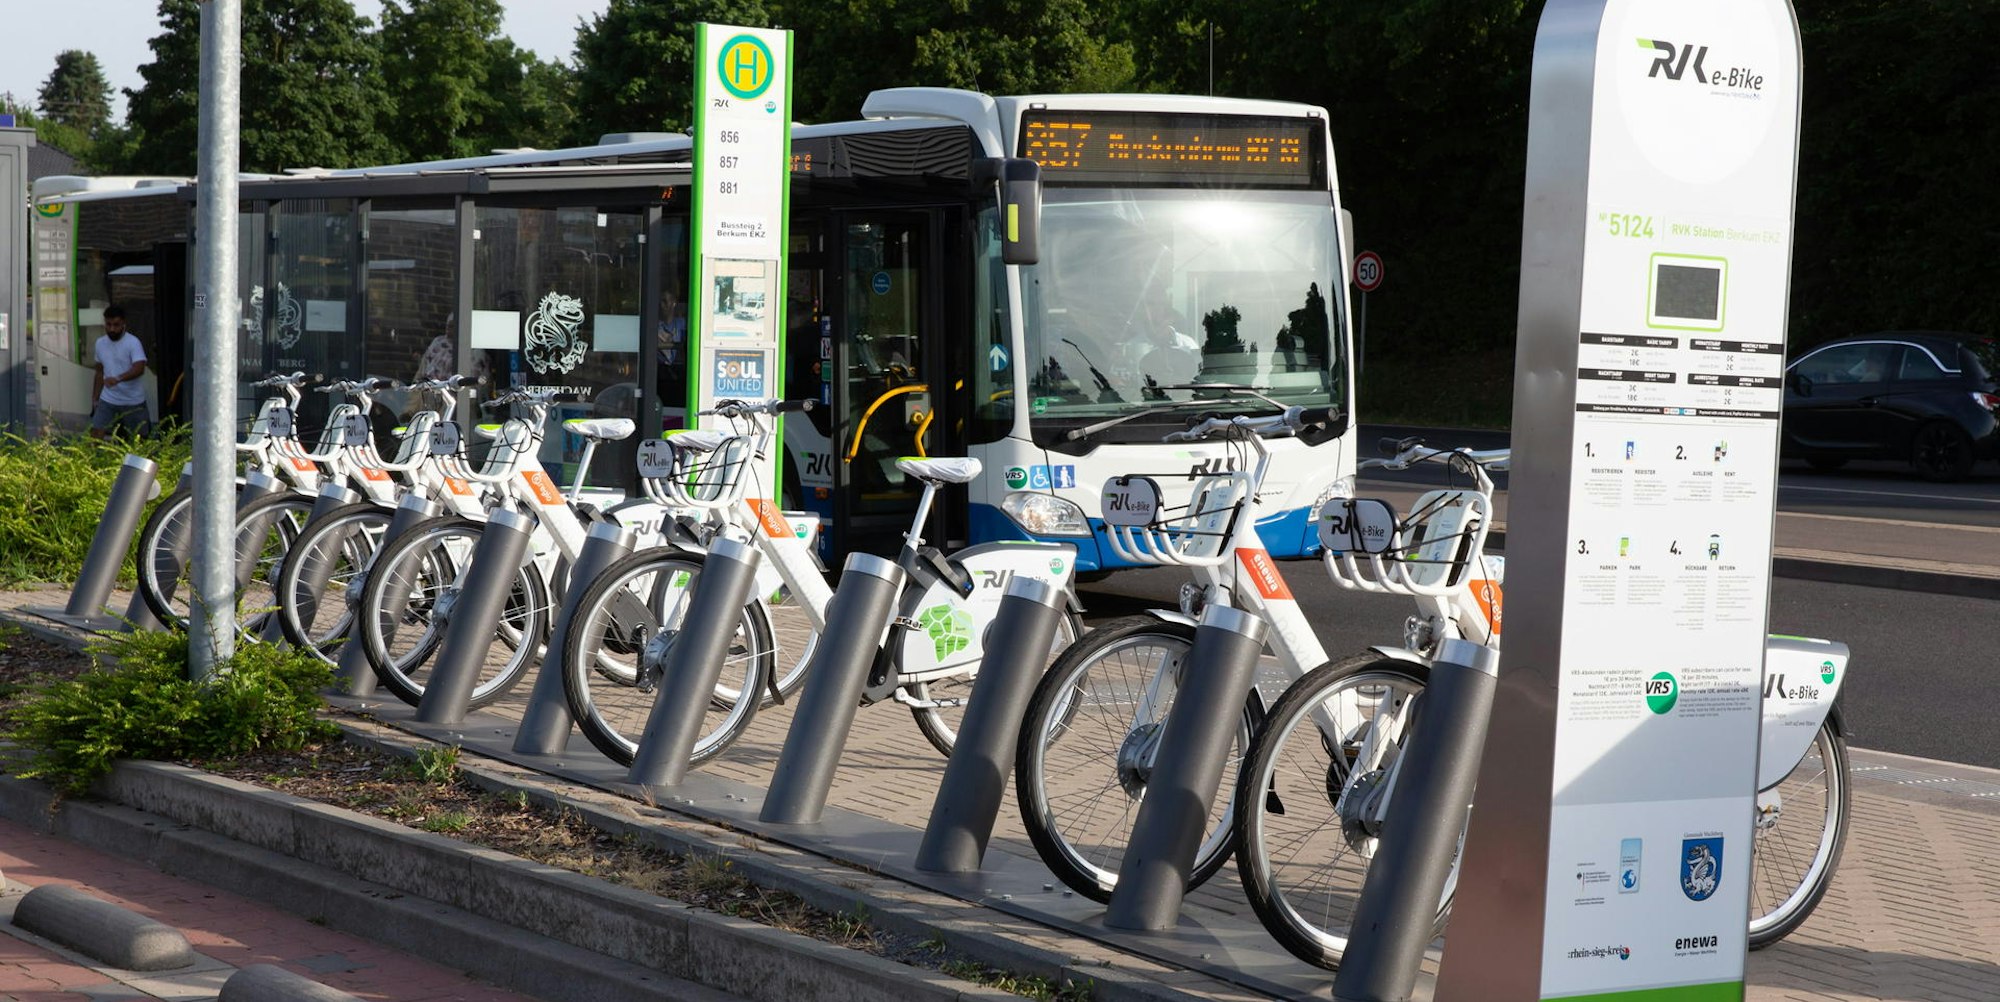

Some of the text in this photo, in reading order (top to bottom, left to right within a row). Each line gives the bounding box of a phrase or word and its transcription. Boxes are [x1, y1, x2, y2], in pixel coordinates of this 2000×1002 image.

[735, 48, 757, 84] H
[1712, 68, 1763, 90] e-Bike
[720, 130, 739, 144] 856
[719, 156, 739, 169] 857
[719, 181, 738, 194] 881
[721, 221, 755, 231] Bussteig
[1609, 213, 1654, 238] 5124
[1672, 223, 1781, 243] RVK Station Berkum EKZ
[1360, 263, 1377, 280] 50
[717, 360, 761, 379] SOUL
[717, 378, 761, 391] UNITED
[1585, 442, 1595, 457] 1.
[1675, 445, 1687, 460] 2.
[800, 452, 831, 476] RVK
[1005, 471, 1022, 479] VRS
[1578, 539, 1589, 554] 3.
[1669, 540, 1681, 555] 4.
[1253, 553, 1278, 592] enewa
[1820, 665, 1831, 673] VRS
[1645, 680, 1671, 695] VRS
[1789, 685, 1819, 699] e-Bike
[1675, 935, 1717, 950] enewa
